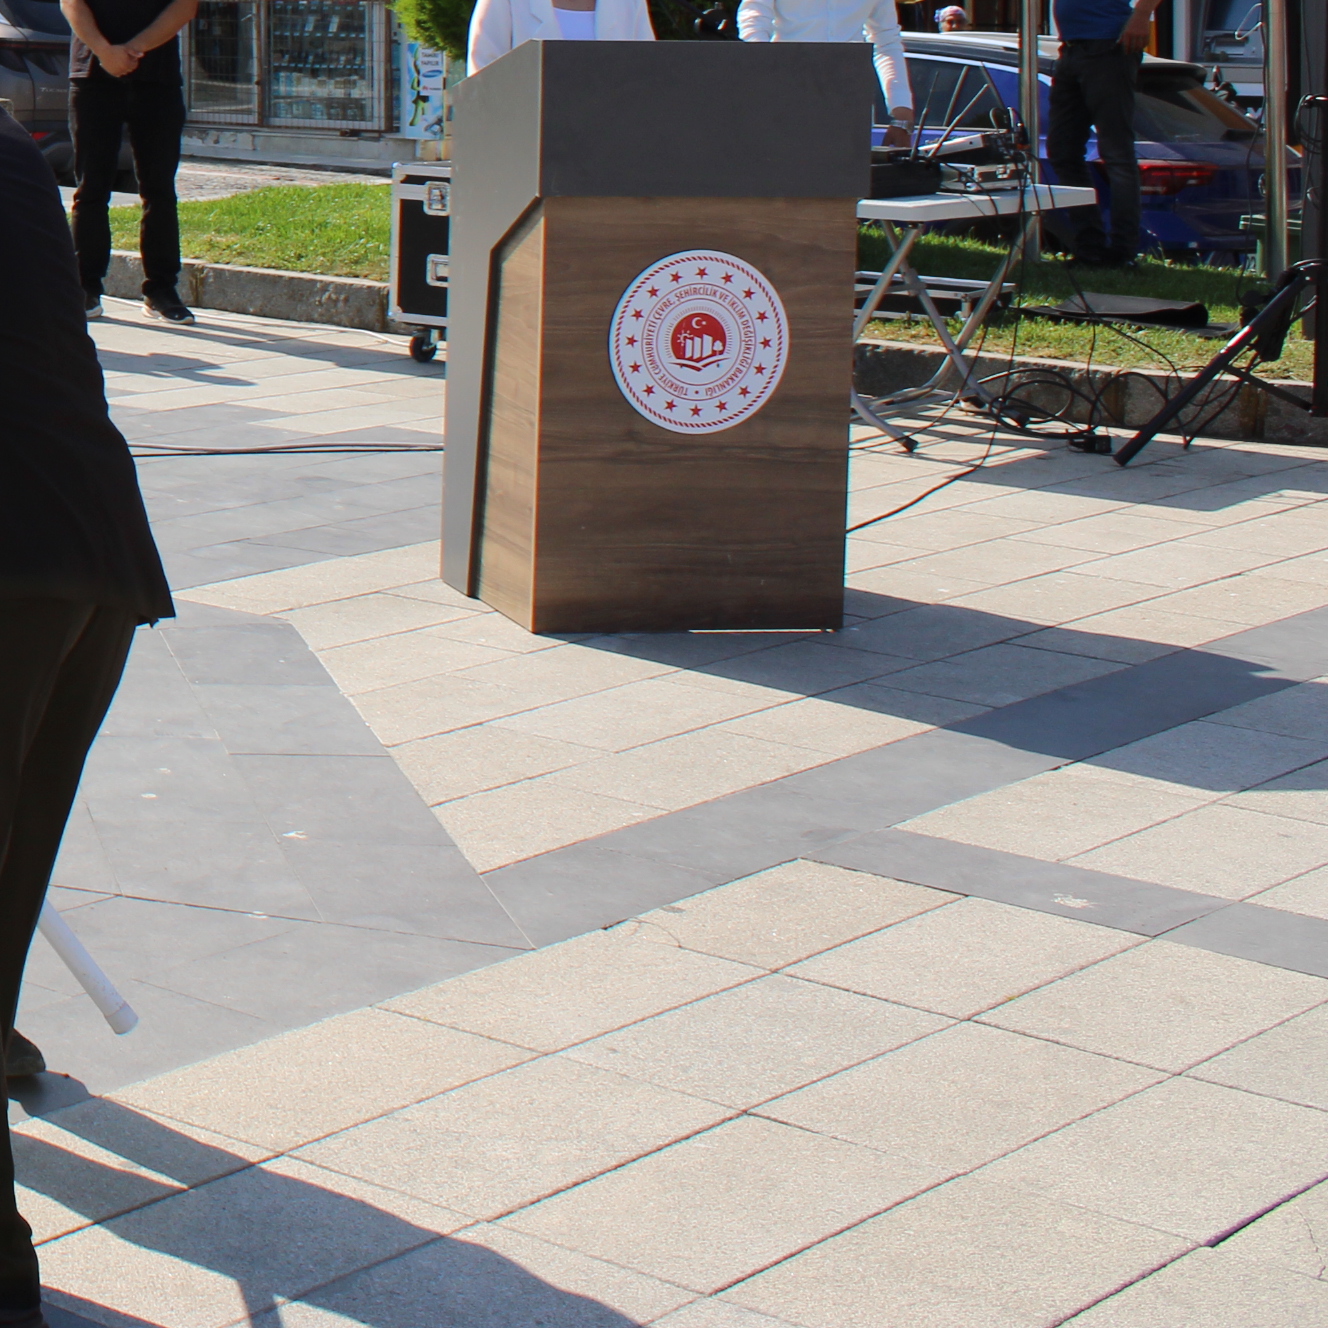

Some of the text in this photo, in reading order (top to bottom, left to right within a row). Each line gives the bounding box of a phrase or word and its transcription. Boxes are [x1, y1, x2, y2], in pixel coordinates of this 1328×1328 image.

[675, 285, 718, 303] ŞEHİRCİLİK
[719, 292, 730, 303] VE
[727, 296, 746, 318] İKLİM
[645, 319, 662, 375] CUMHURİYETİ
[658, 373, 688, 397] TÜRKİYE
